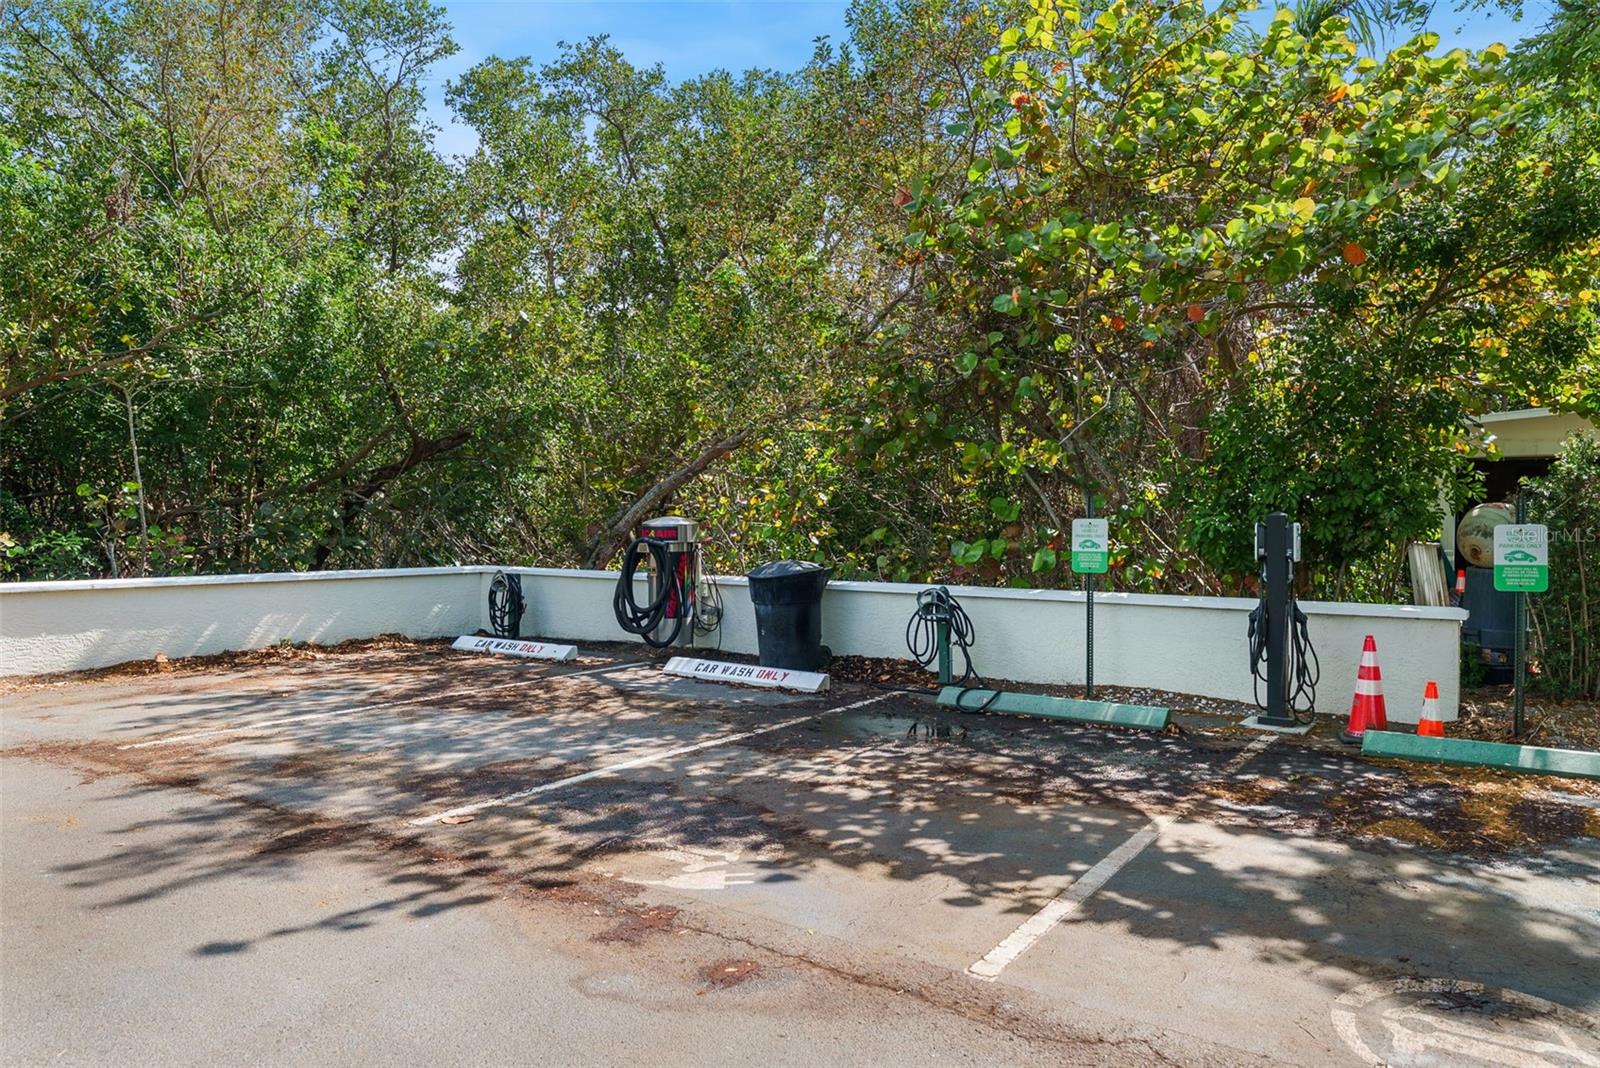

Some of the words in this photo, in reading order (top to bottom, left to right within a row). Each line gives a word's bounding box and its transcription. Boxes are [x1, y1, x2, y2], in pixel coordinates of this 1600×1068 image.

[474, 639, 494, 648] CAR
[494, 640, 519, 651] WASH
[519, 643, 544, 653] ONLY
[694, 662, 719, 673] CAR
[721, 665, 755, 677] WASH
[756, 669, 790, 682] ONLY
